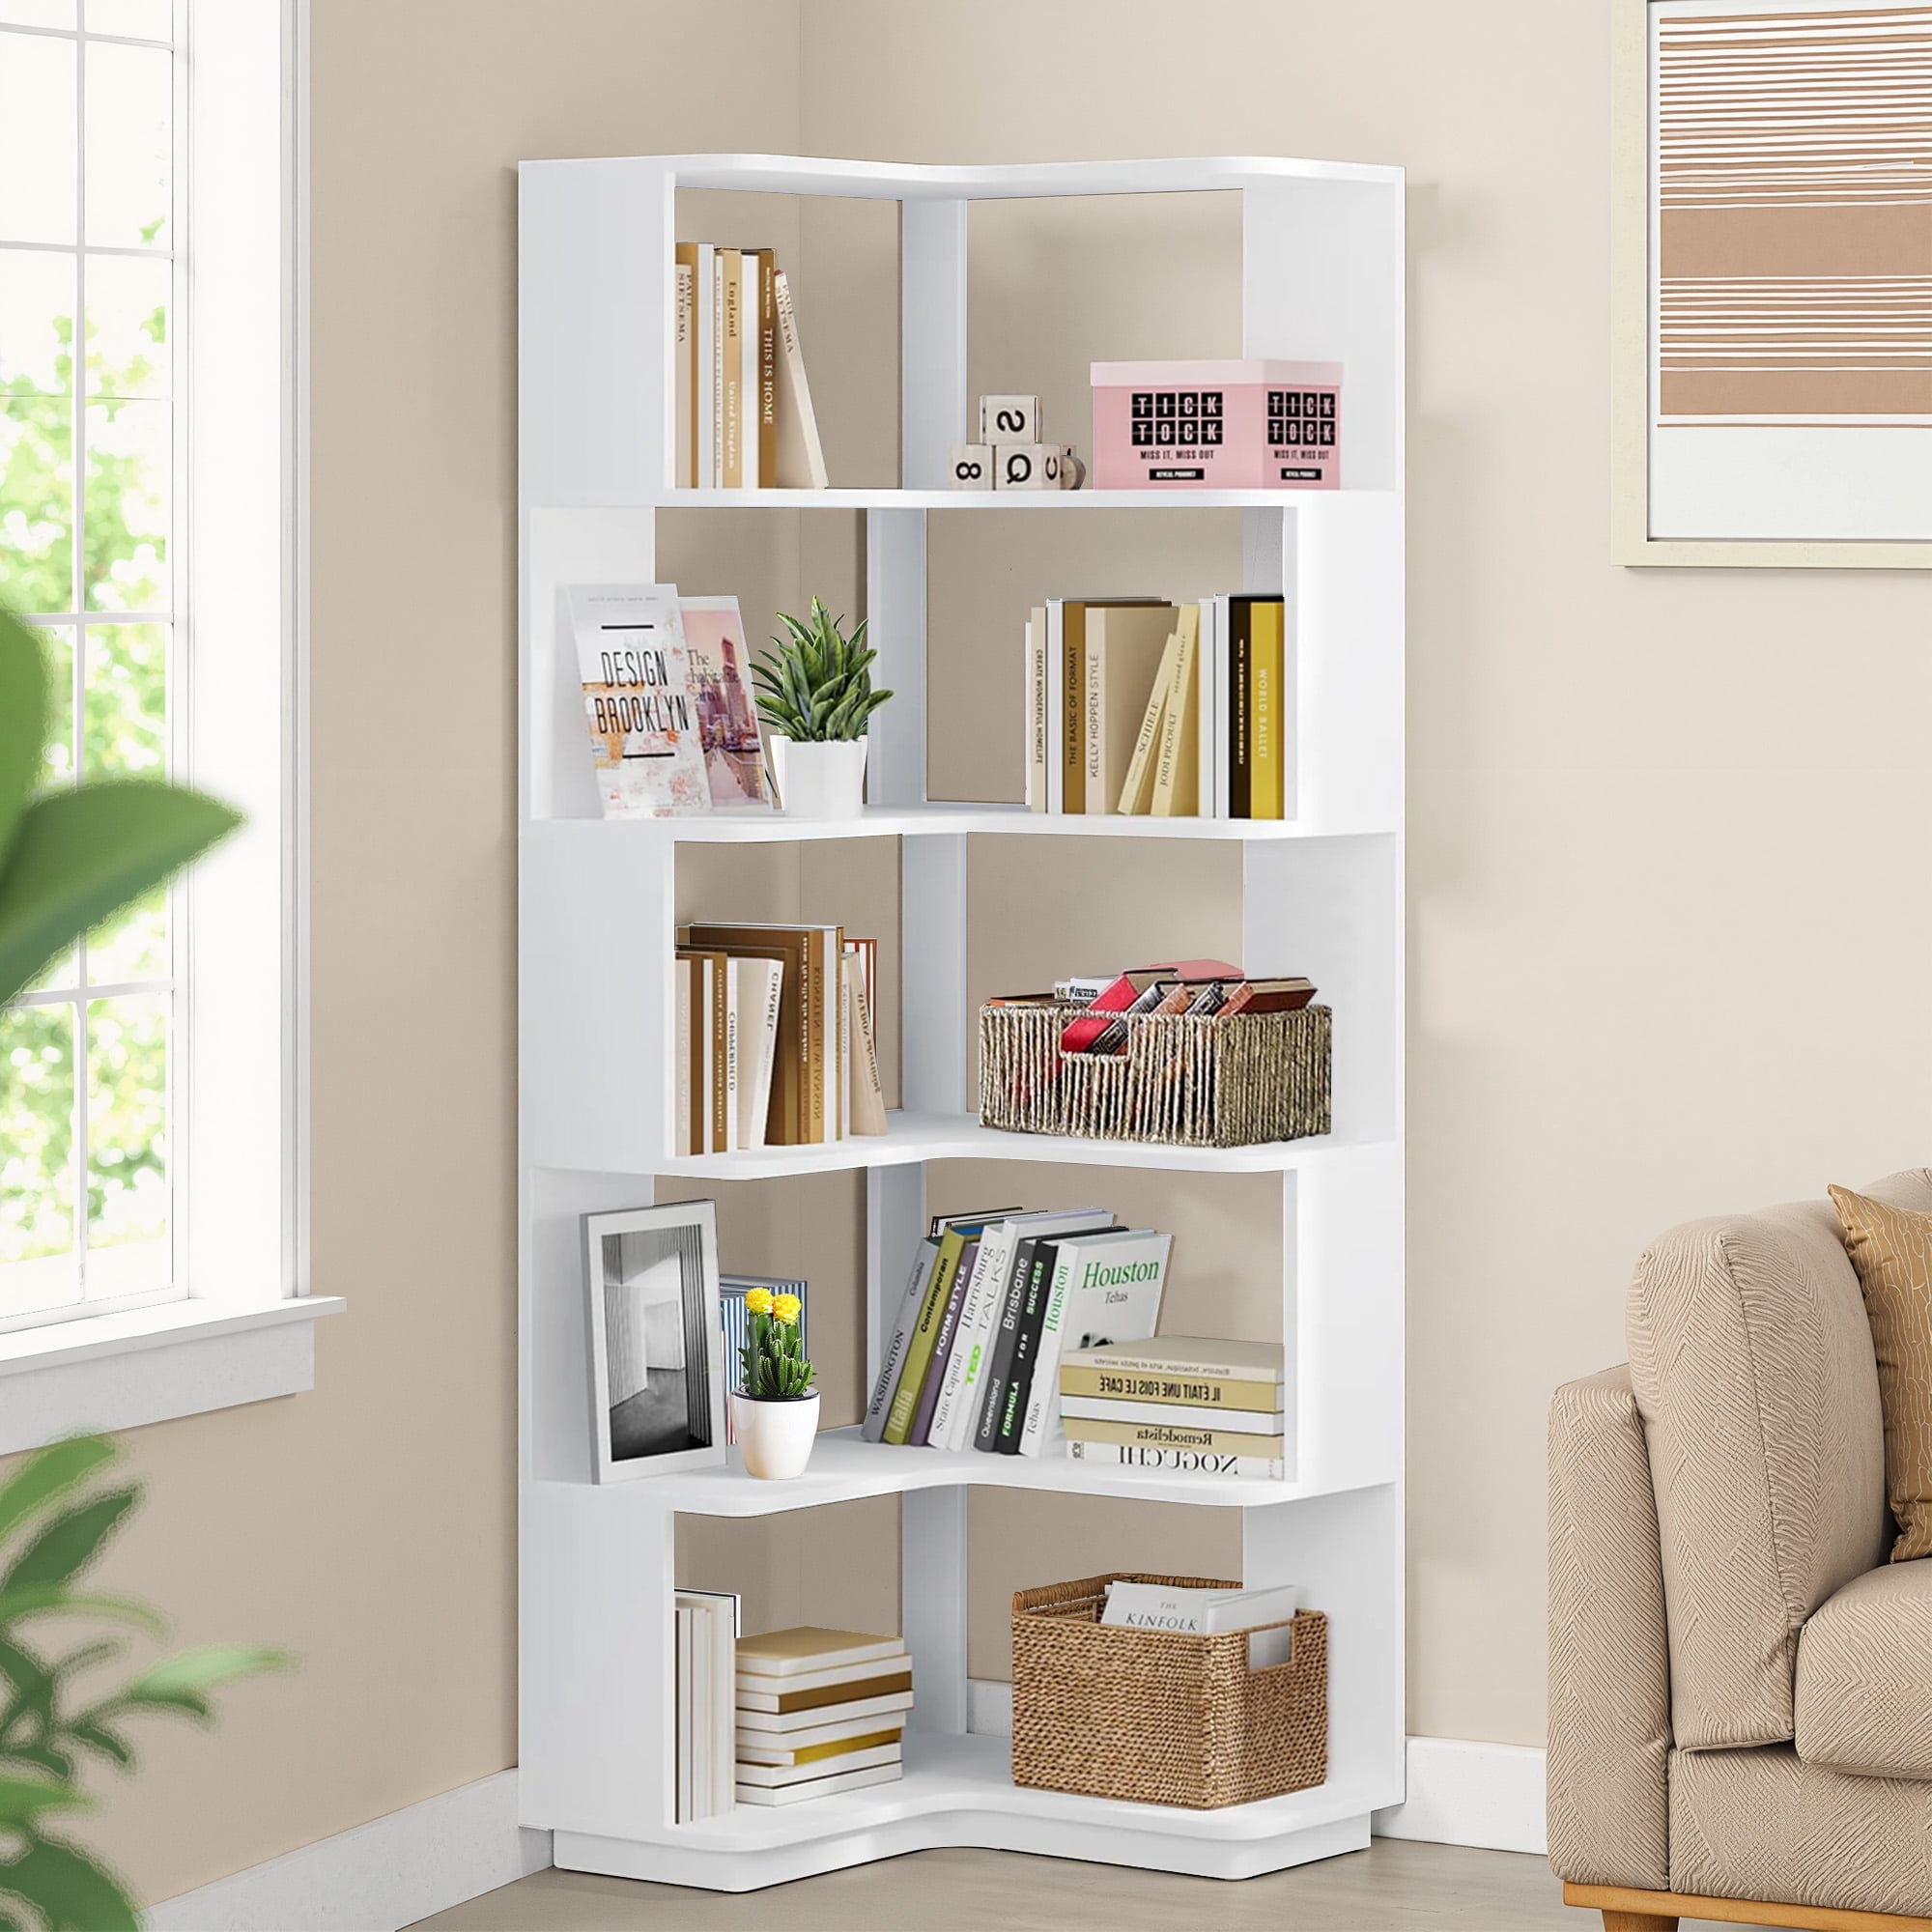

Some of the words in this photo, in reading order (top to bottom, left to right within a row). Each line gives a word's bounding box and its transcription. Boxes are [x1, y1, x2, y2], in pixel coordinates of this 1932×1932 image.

[726, 281, 737, 337] England
[764, 327, 773, 361] THIS
[764, 364, 773, 377] IS
[764, 381, 773, 424] HOME
[1138, 396, 1217, 414] TICK
[1272, 396, 1332, 414] TICK
[1138, 423, 1217, 441] TOCK
[1272, 423, 1332, 441] TOCK
[1140, 450, 1161, 460] MISS
[1162, 450, 1173, 461] IT,
[1176, 450, 1197, 460] MISS
[1199, 450, 1214, 459] OUT
[1273, 450, 1290, 459] MISS
[1300, 450, 1317, 460] MISS
[1318, 450, 1329, 460] OUT
[687, 648, 710, 666] The
[1177, 634, 1187, 663] glance
[600, 647, 669, 688] DESIGN
[1068, 645, 1077, 691] FORMAT
[1089, 654, 1098, 689] STYLE
[1173, 664, 1182, 694] second
[1068, 695, 1077, 709] OF
[1259, 668, 1267, 712] WORLD
[594, 695, 690, 734] BROOKLYN
[1068, 711, 1077, 743] BASIC
[1090, 692, 1099, 739] HOPPEN
[1138, 700, 1159, 754] SCHIELE
[1163, 712, 1178, 758] PICOULT
[1259, 717, 1267, 759] BALLET
[1068, 746, 1077, 765] THE
[1090, 742, 1099, 778] KELLY
[1159, 760, 1170, 787] JODI
[1082, 1261, 1159, 1289] Houston
[935, 1314, 954, 1356] FORM
[949, 1264, 968, 1311] STYLE
[1104, 1291, 1129, 1304] Tehas
[964, 1344, 981, 1385] TED
[979, 1248, 1007, 1330] TALKS
[935, 1397, 952, 1432] State
[945, 1352, 964, 1397] Capital
[960, 1246, 995, 1330] Harrisburg
[980, 1378, 1001, 1438] Queensland
[1002, 1257, 1029, 1330] Brisbane
[1002, 1380, 1020, 1437] FORMULA
[1017, 1333, 1029, 1359] FOR
[1026, 1261, 1044, 1315] SUCCESS
[1027, 1402, 1040, 1435] Tehas
[1044, 1264, 1069, 1332] Houston
[871, 1329, 905, 1415] WASHINGTON
[888, 1389, 914, 1434] Italia
[1125, 1610, 1199, 1632] KINFOLK
[1159, 1601, 1179, 1610] THE
